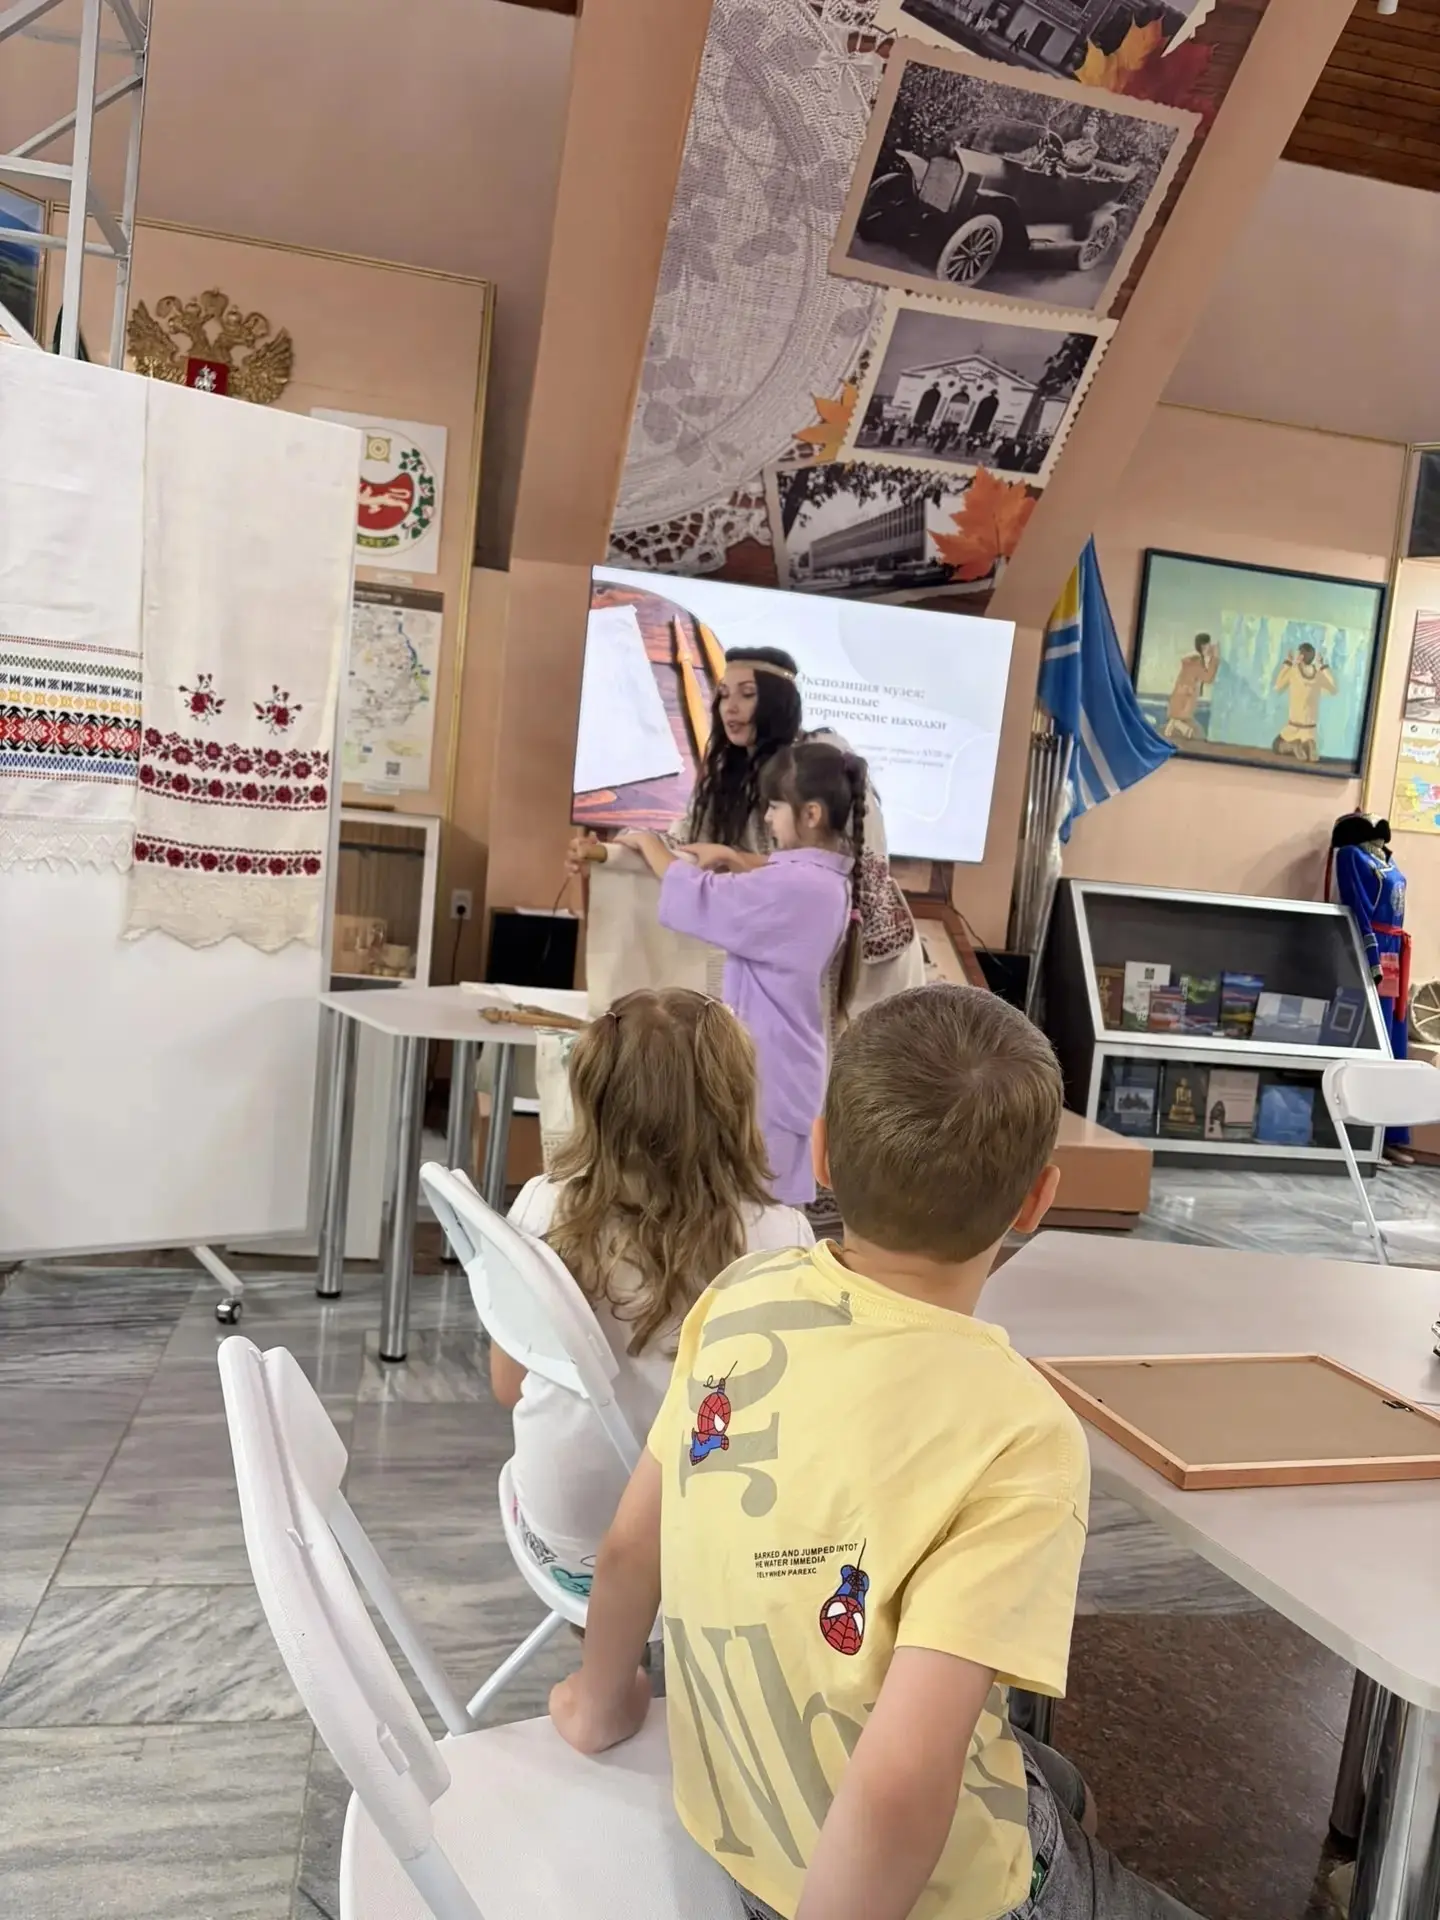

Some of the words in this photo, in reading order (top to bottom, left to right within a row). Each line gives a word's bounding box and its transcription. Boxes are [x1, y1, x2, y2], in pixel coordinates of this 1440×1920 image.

[804, 690, 880, 708] никальные
[808, 706, 889, 724] торические
[891, 716, 948, 731] находки
[754, 1550, 781, 1560] BARKED
[781, 1549, 800, 1558] AND
[801, 1546, 836, 1556] JUMPED
[764, 1558, 789, 1568] WATER
[790, 1555, 826, 1566] IMMEDIA
